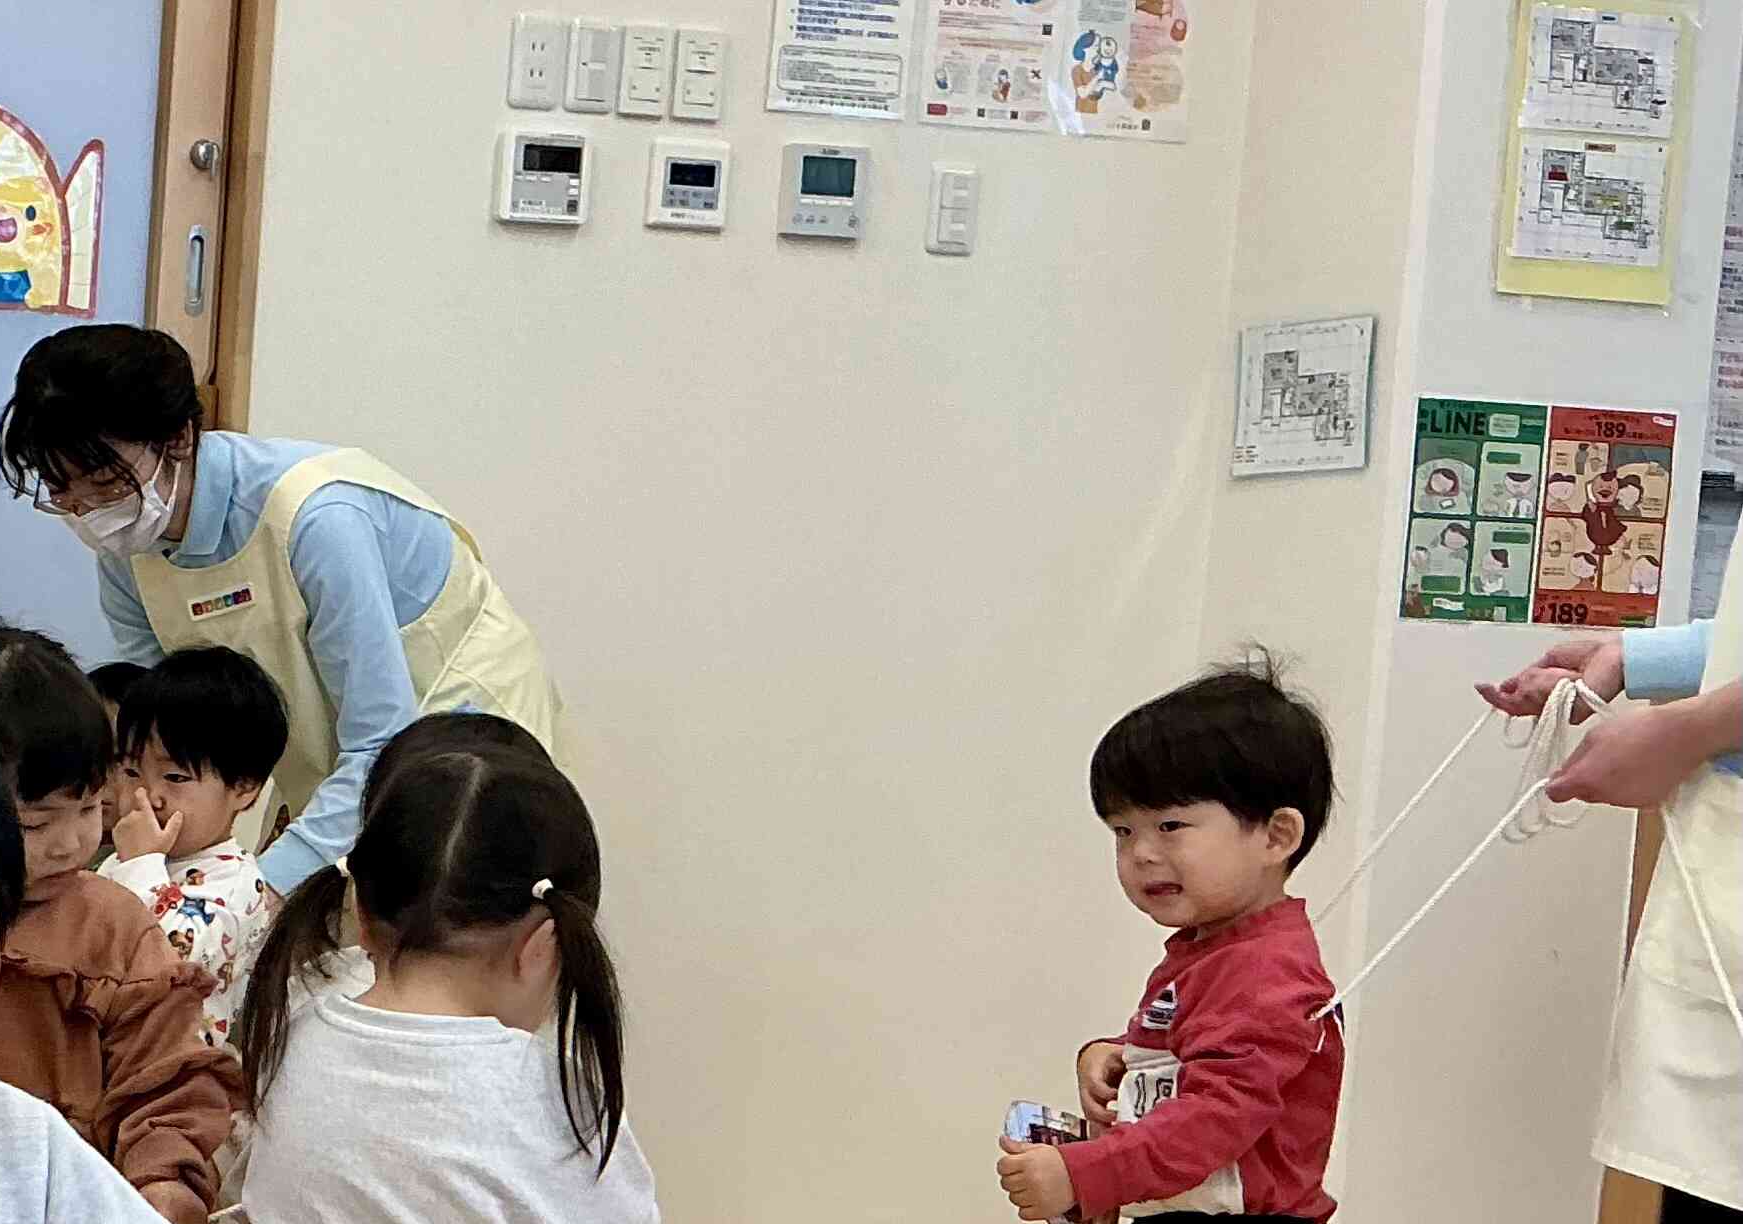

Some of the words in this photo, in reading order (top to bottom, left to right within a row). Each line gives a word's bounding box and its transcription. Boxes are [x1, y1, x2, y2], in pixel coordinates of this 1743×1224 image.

[1429, 408, 1487, 436] LINE
[1594, 420, 1627, 439] 189
[1547, 602, 1588, 625] 189
